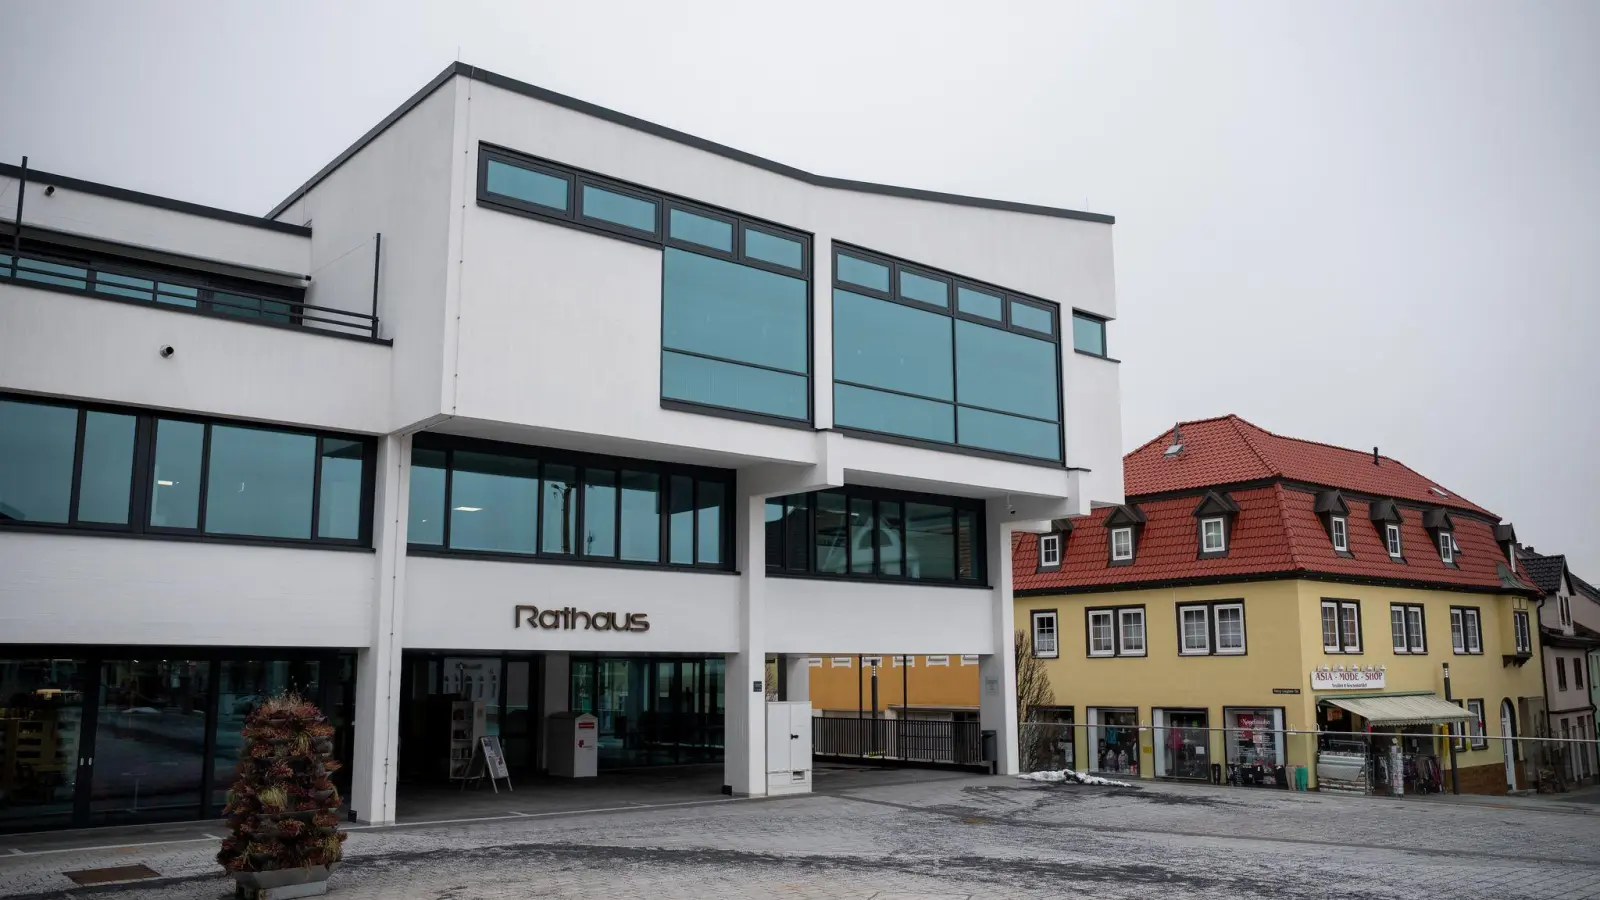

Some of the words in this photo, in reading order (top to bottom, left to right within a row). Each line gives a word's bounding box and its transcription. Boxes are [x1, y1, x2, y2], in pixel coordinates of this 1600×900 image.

[515, 604, 650, 632] Rathaus
[1315, 672, 1333, 681] ASIA
[1339, 672, 1360, 681] MODE
[1365, 672, 1383, 681] SHOP
